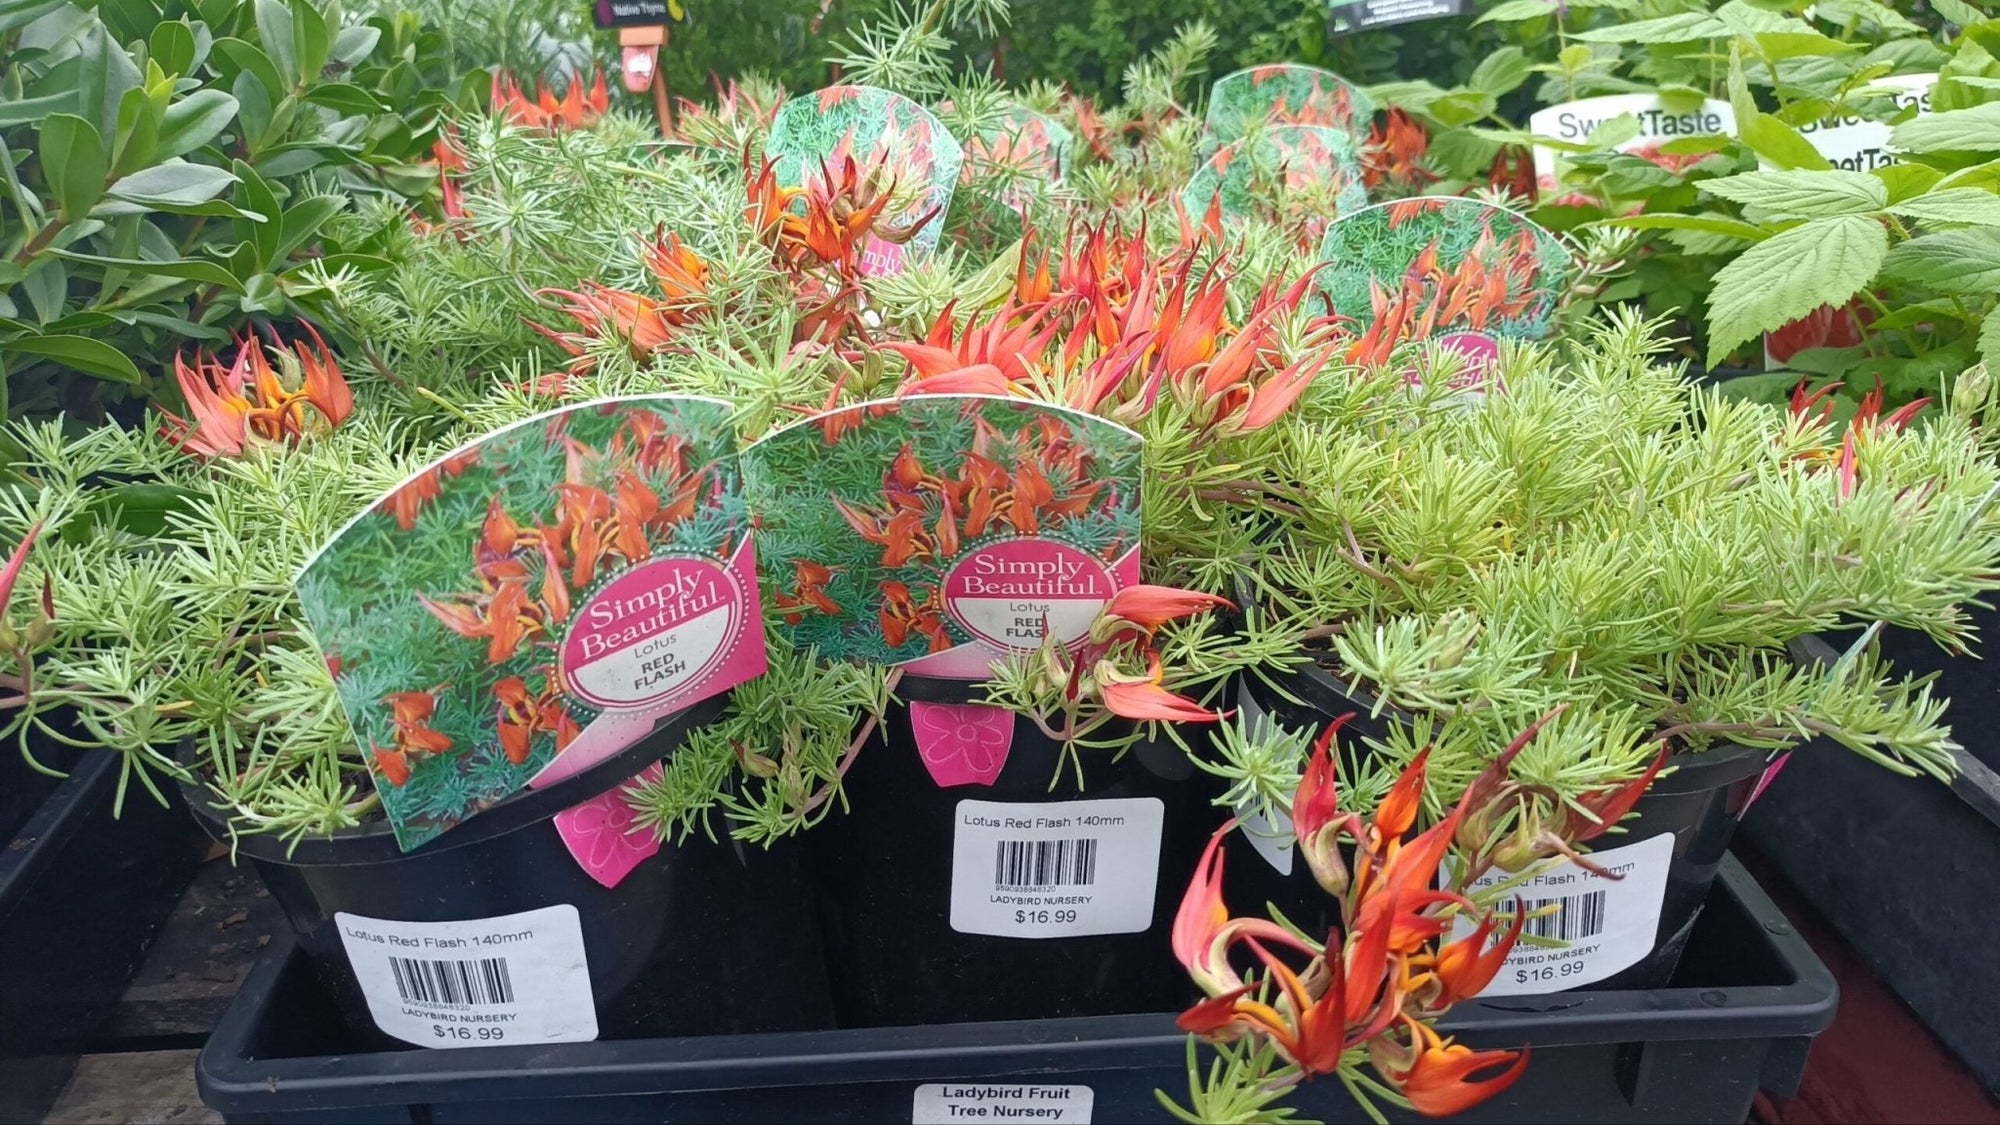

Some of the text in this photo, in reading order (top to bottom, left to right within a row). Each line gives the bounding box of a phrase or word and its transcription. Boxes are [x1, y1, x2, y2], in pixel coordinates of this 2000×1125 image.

[1558, 109, 1721, 138] SwtTaste
[975, 552, 1085, 580] Simply
[962, 574, 1096, 595] Beautiful
[589, 567, 703, 630] Simply
[1010, 602, 1050, 613] Lotus
[580, 581, 720, 660] Beautiful
[1006, 628, 1044, 638] FLAS
[634, 634, 677, 659] Lotus
[641, 652, 675, 674] RED
[634, 660, 686, 690] FLASH
[964, 814, 1125, 829] Lotus Red Flash 140mm
[1534, 873, 1575, 886] Flash
[990, 895, 1093, 905] LADYBIRD NURSERY
[1015, 909, 1077, 924] $16.99
[345, 926, 534, 949] Lotus Red Flash 140mm
[1547, 943, 1601, 961] NURSERY
[1516, 961, 1584, 984] $16.99
[401, 1007, 518, 1023] LADYBIRD NURSERY
[432, 1024, 504, 1040] $16.99
[942, 1086, 1071, 1101] Ladybird Fruit
[948, 1104, 1064, 1120] Tree Nursery
